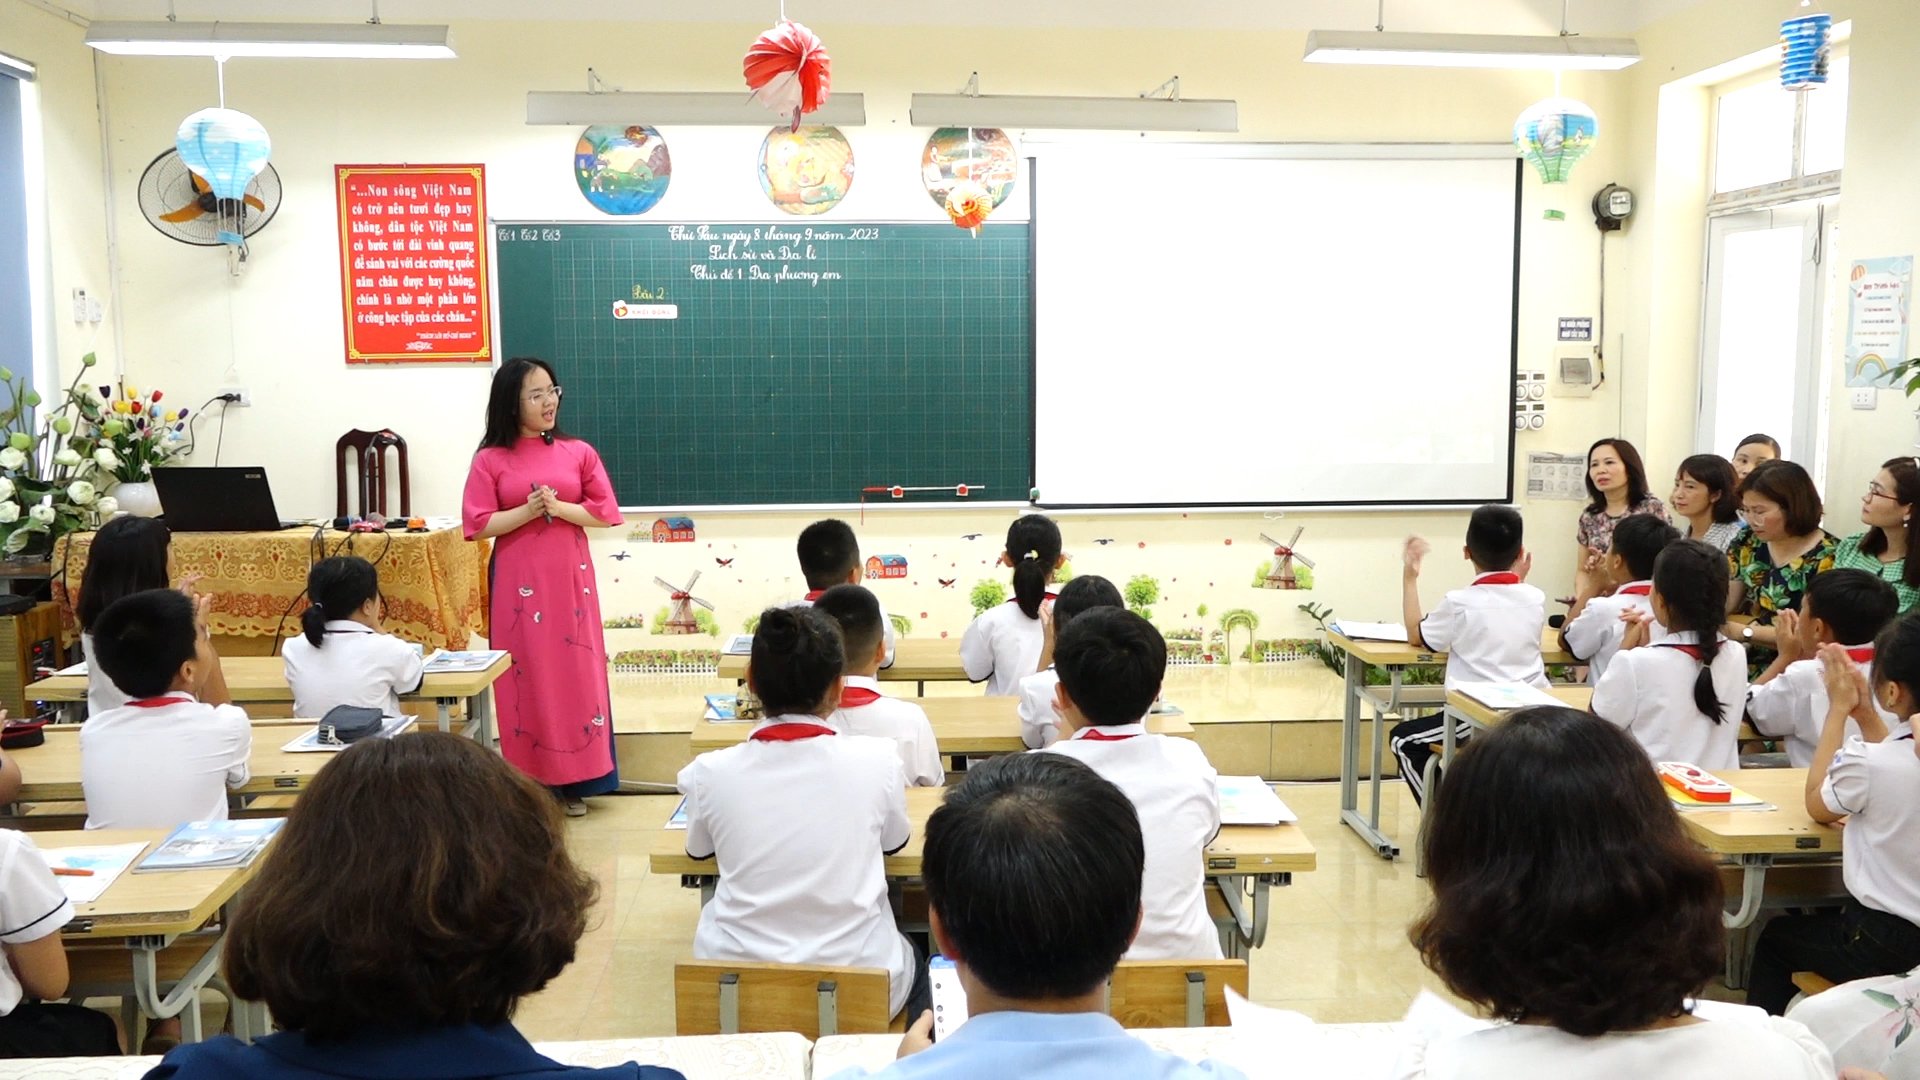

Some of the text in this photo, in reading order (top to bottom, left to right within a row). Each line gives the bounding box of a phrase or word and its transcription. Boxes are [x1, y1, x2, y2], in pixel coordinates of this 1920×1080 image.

[393, 184, 417, 199] sông
[422, 184, 444, 198] Việt
[449, 184, 472, 196] Nam
[352, 203, 363, 215] có
[388, 202, 404, 215] nên
[409, 203, 429, 215] tươi
[434, 202, 450, 217] đẹp
[456, 202, 472, 217] hay
[388, 220, 405, 233] dân
[410, 220, 424, 235] tộc
[428, 220, 447, 235] Việt
[452, 220, 473, 233] Nam
[760, 249, 776, 260] và
[737, 268, 743, 280] 1
[774, 264, 820, 288] phương
[822, 271, 842, 280] em
[656, 286, 665, 300] 2
